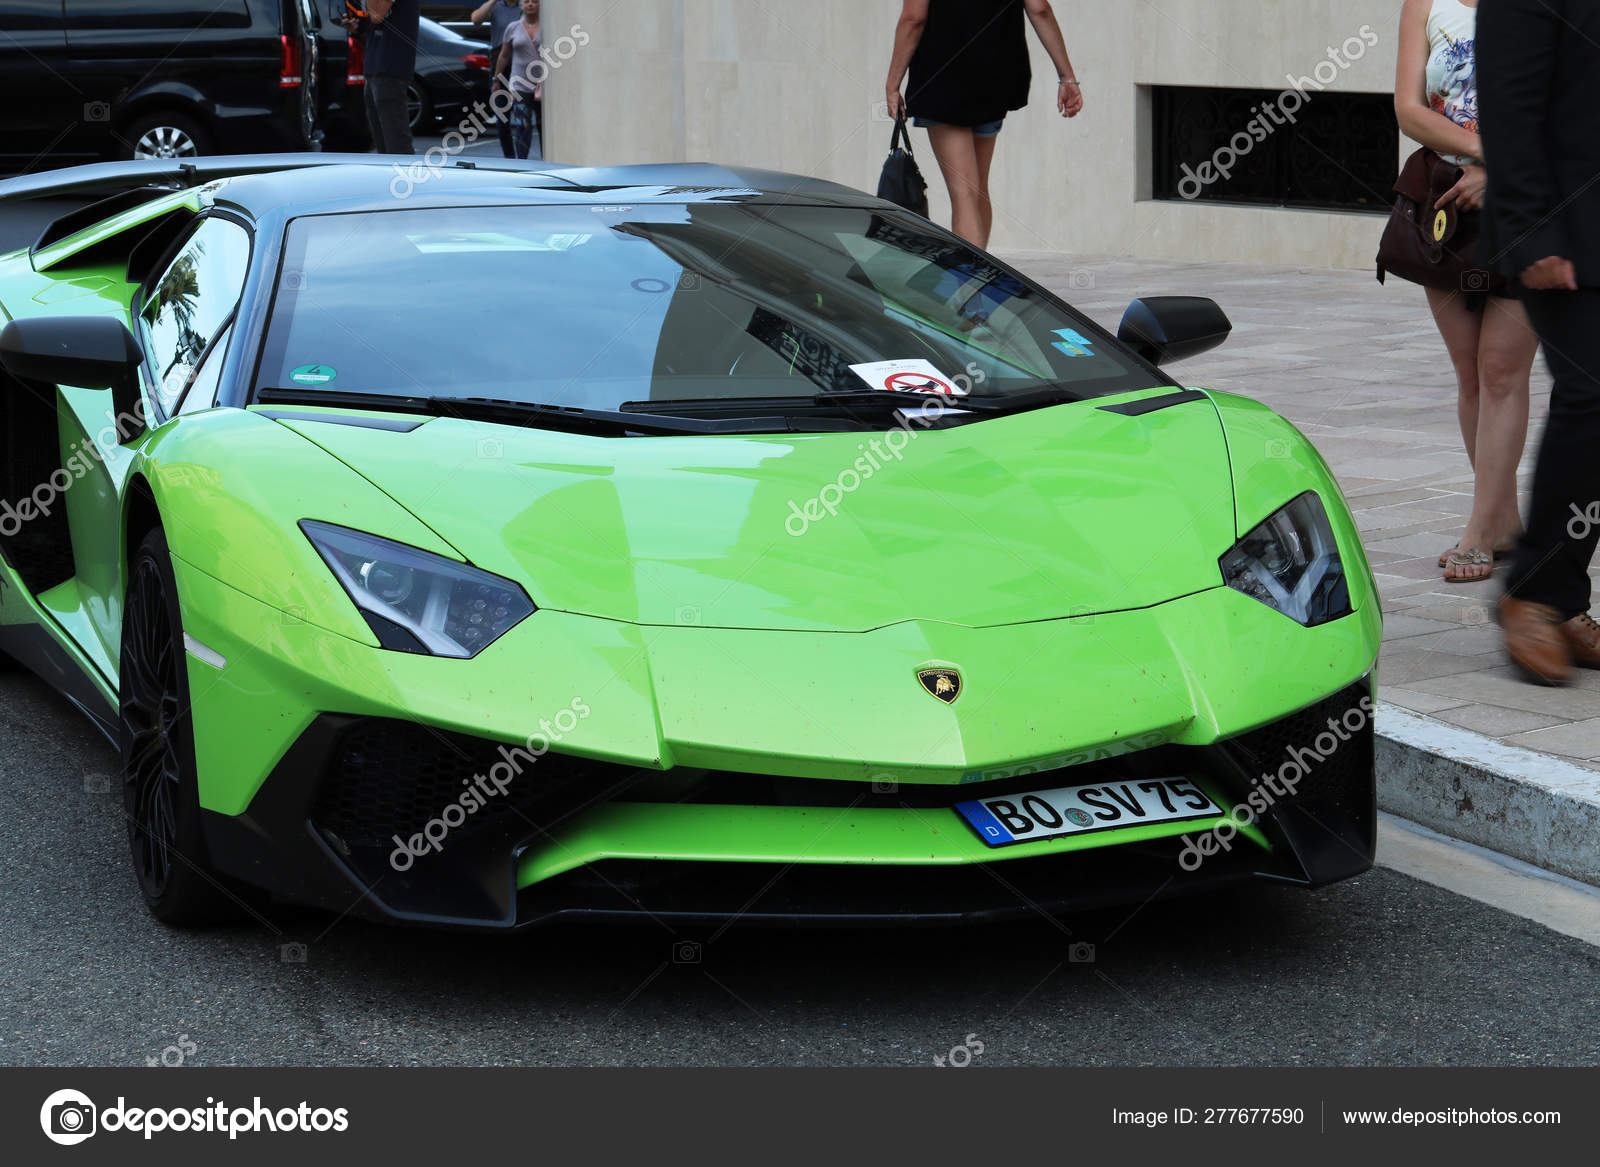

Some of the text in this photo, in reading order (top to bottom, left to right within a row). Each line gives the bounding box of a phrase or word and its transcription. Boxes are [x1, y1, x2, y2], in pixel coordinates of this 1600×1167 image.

[984, 779, 1211, 835] BO SV 75
[984, 826, 1000, 838] D
